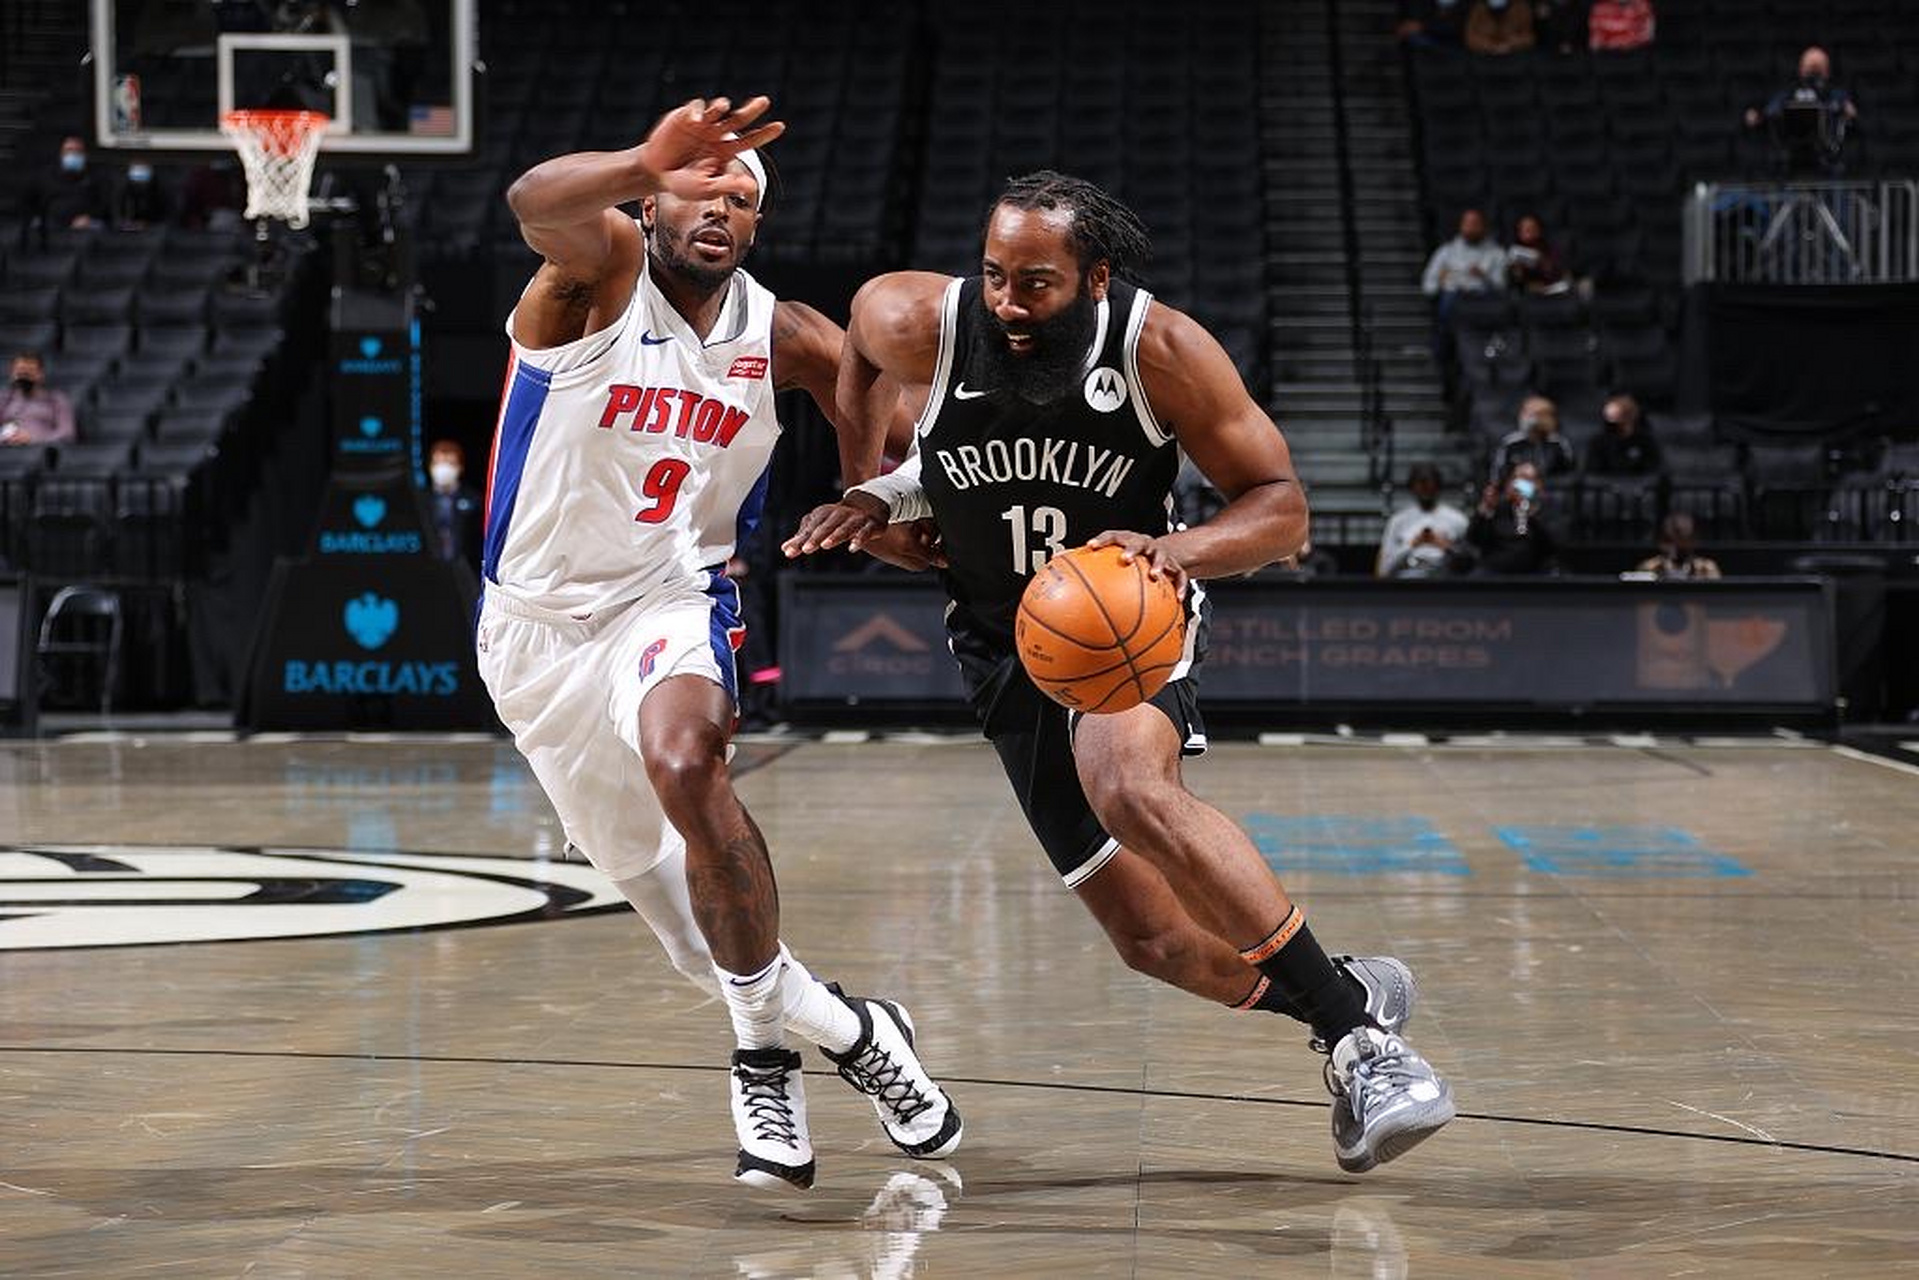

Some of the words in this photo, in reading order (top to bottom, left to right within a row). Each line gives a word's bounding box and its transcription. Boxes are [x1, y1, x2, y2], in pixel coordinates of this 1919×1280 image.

[598, 384, 750, 449] PISTON
[635, 457, 690, 524] 9
[937, 437, 1135, 499] BROOKLYN
[319, 531, 421, 554] BARCLAYS
[1002, 505, 1067, 576] 13
[1209, 617, 1379, 640] STILLED
[1389, 617, 1513, 640] FROM
[283, 659, 460, 696] BARCLAYS
[1203, 644, 1309, 667] ENCH
[1321, 645, 1490, 669] GRAPES
